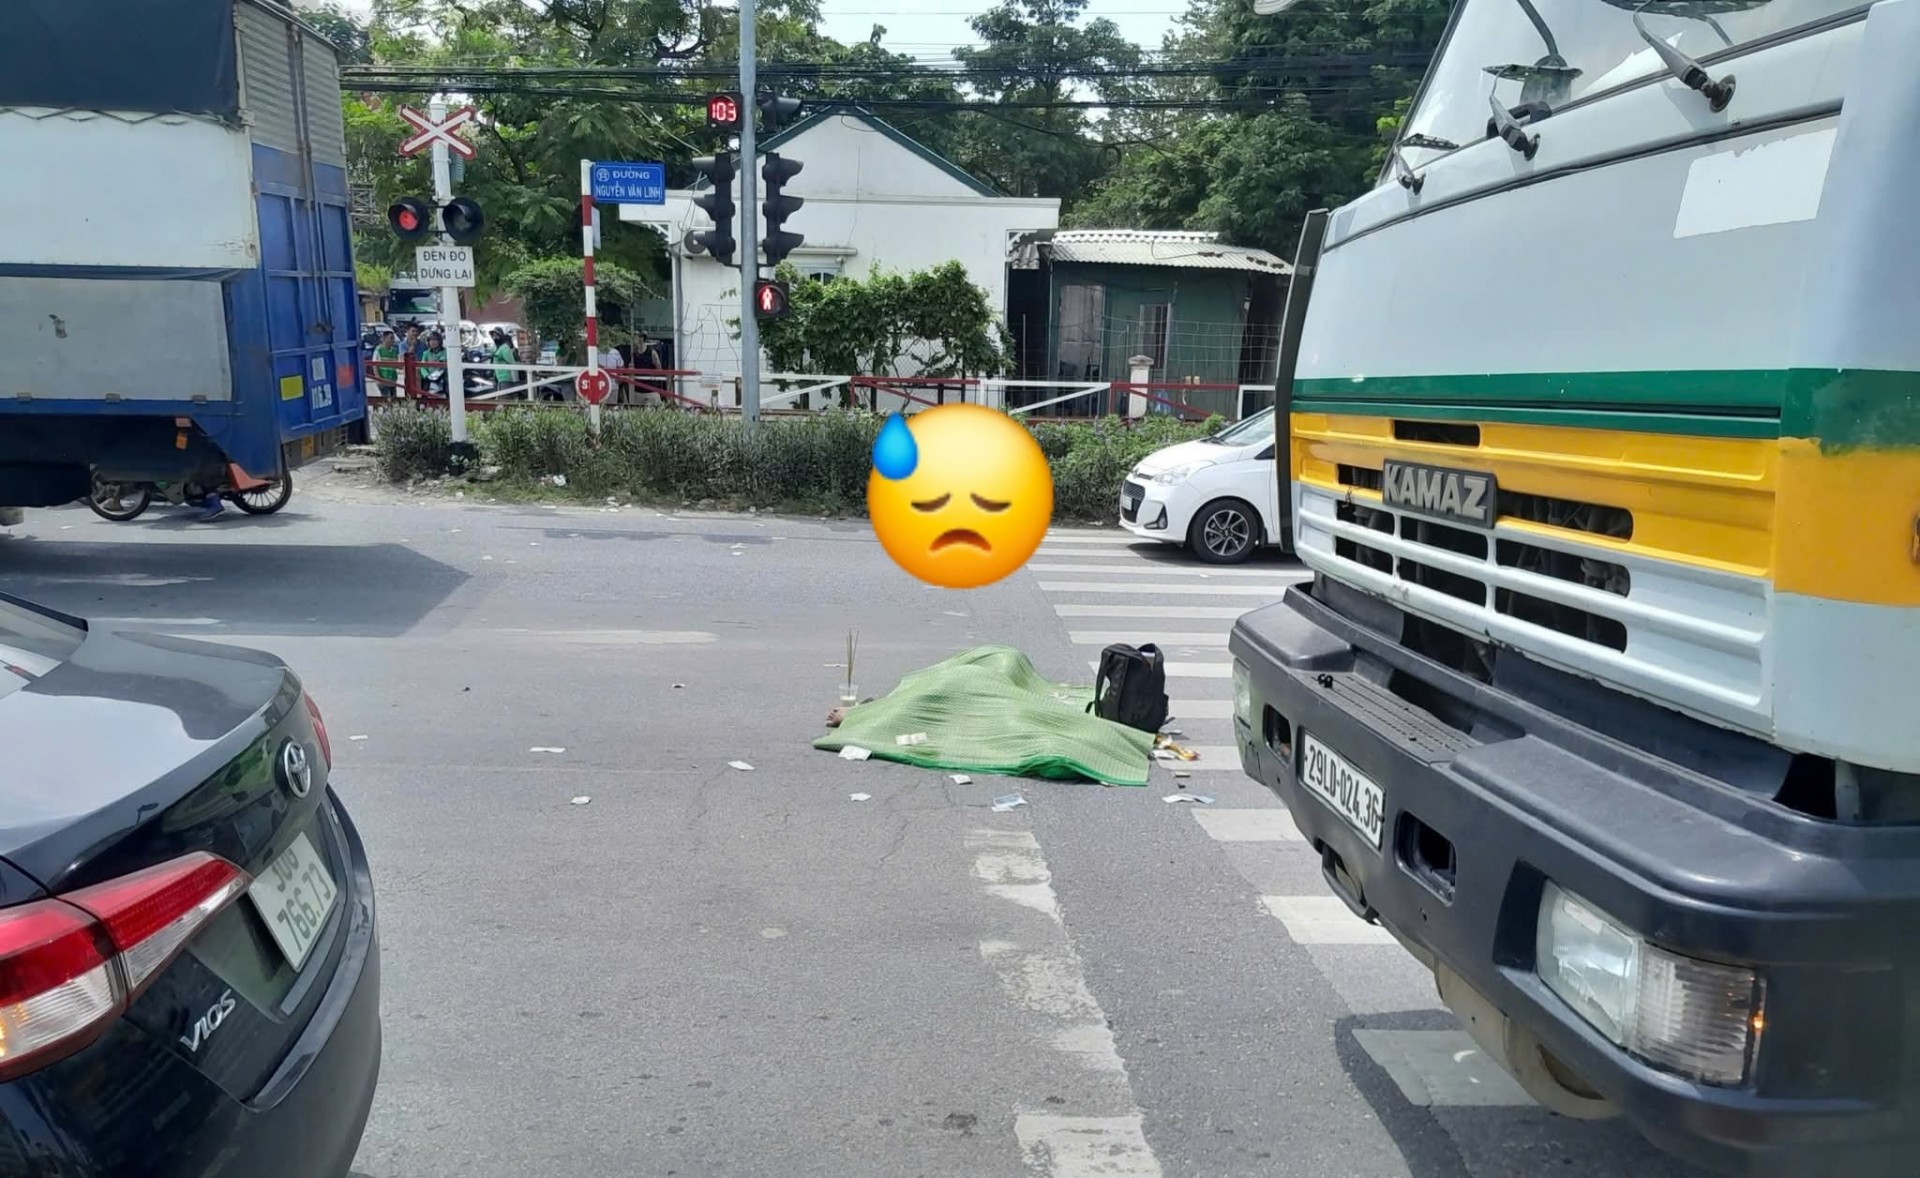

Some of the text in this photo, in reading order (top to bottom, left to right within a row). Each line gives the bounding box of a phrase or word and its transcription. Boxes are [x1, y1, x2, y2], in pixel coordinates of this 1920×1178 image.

[712, 102, 737, 121] 103
[612, 166, 650, 180] ĐƯỜNG
[644, 187, 661, 199] LINH
[423, 247, 466, 262] ĐÈN ĐỎ
[455, 269, 472, 281] LẠI
[581, 379, 606, 391] SP
[1385, 463, 1489, 520] KAMAZ
[1309, 744, 1380, 834] 29LD-024.36
[277, 862, 331, 953] 766.73
[180, 988, 236, 1052] VIOS
